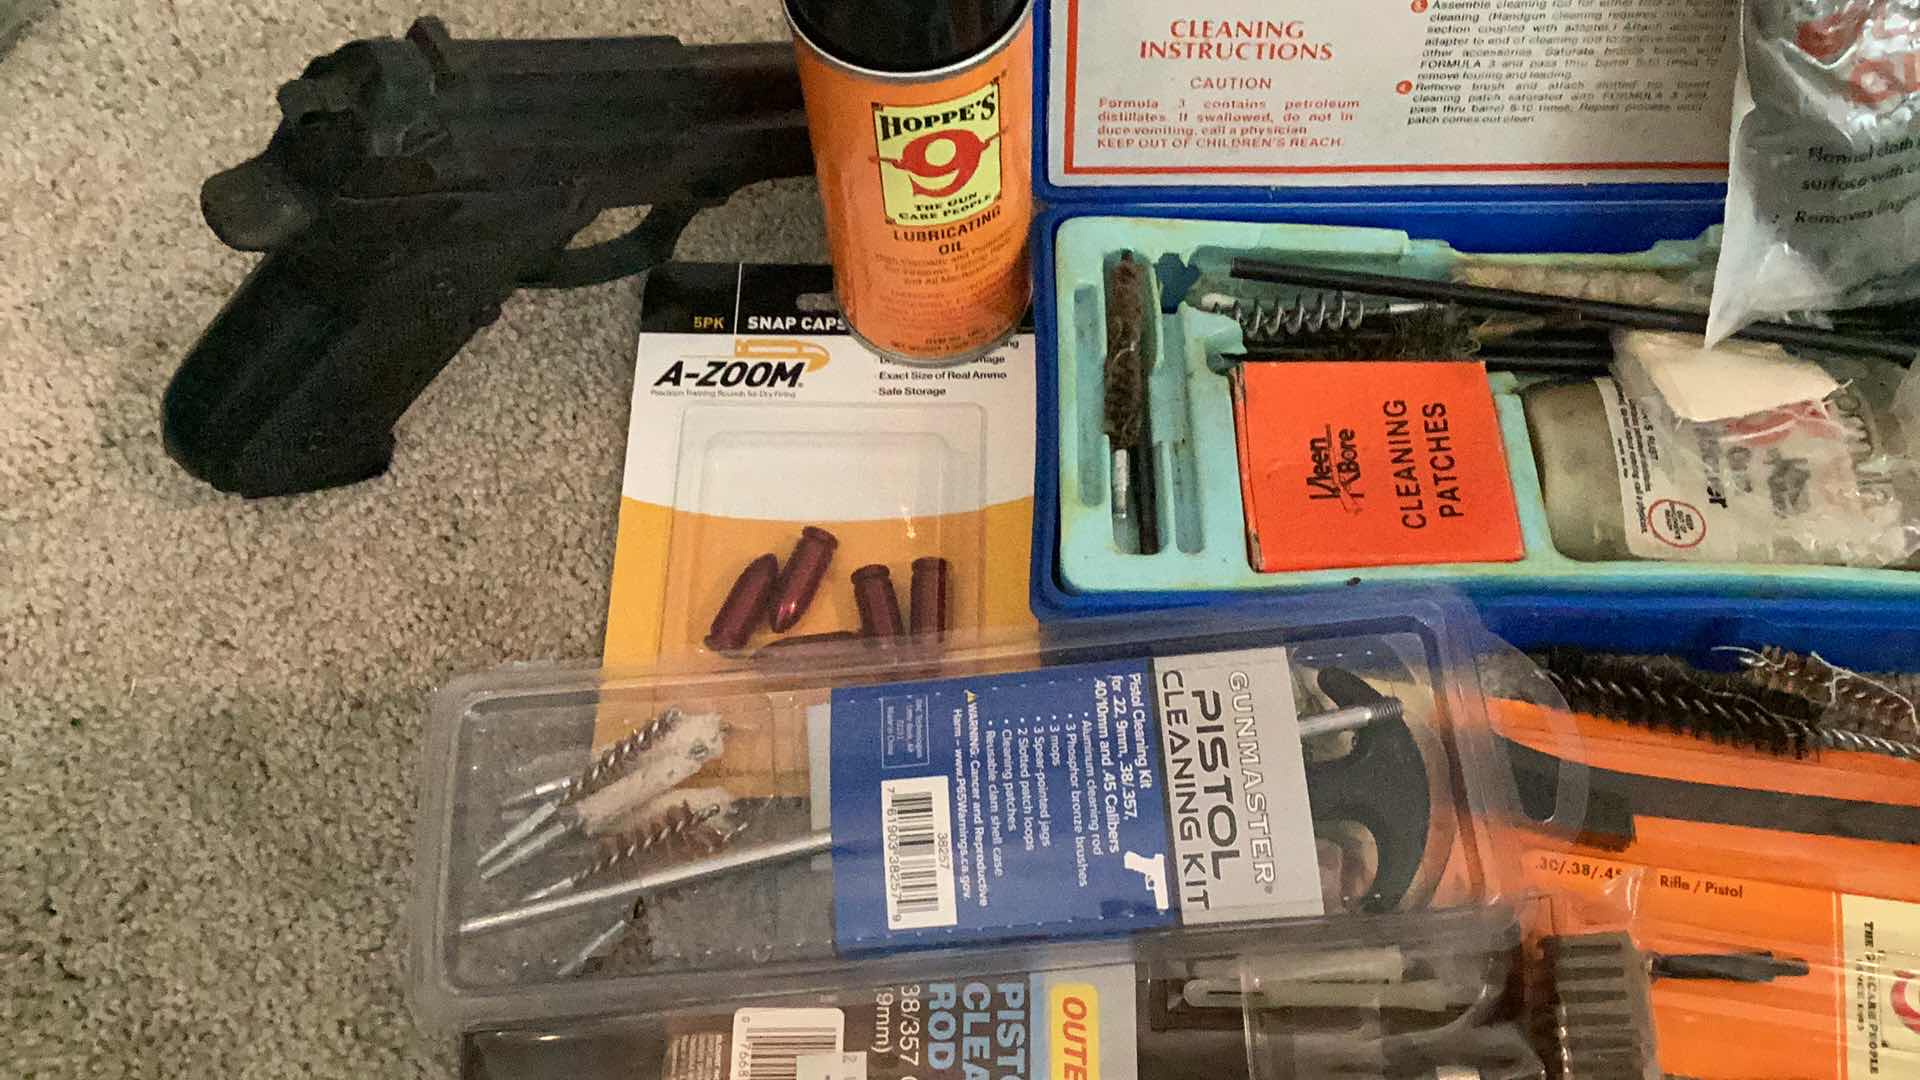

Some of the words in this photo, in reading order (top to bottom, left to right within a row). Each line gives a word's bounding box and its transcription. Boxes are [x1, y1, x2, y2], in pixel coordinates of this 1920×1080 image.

[1170, 19, 1304, 38] CLEANING
[1426, 25, 1470, 34] section
[1533, 24, 1558, 33] with
[1429, 12, 1480, 22] cleaning
[1139, 41, 1333, 60] INSTRUCTIONS
[1419, 59, 1481, 69] FORMULA
[1422, 49, 1453, 58] other
[1190, 77, 1272, 90] CAUTION
[1415, 82, 1462, 91] Remove
[1098, 97, 1159, 109] Formula
[1203, 99, 1267, 109] contains
[1284, 99, 1360, 111] petroleum
[1409, 106, 1437, 115] pass
[1442, 104, 1466, 114] thru
[1412, 94, 1461, 104] cleaning
[879, 92, 997, 141] HOPPE'S
[1097, 124, 1131, 135] duce
[1201, 124, 1228, 135] call
[1229, 126, 1237, 135] a
[1196, 111, 1274, 124] swallowed,
[1283, 111, 1300, 122] do
[1308, 112, 1332, 122] not
[1406, 116, 1440, 126] patch
[1441, 116, 1480, 125] comes
[1481, 115, 1501, 124] out
[1097, 138, 1135, 149] KEEP
[1138, 138, 1168, 148] OUT
[1171, 138, 1191, 148] OF
[1196, 137, 1286, 149] CHILDREN'S
[895, 129, 988, 197] 9
[1801, 178, 1868, 192] surface
[898, 211, 938, 221] CARE
[943, 195, 992, 217] PEOPLE
[914, 202, 943, 212] THE
[947, 192, 979, 207] GUN
[1795, 209, 1874, 224] Removes
[893, 204, 1001, 242] LUBRICATING
[938, 241, 962, 256] OIL
[693, 316, 725, 330] 5PK
[747, 316, 797, 330] SNAP
[800, 317, 847, 331] CAPS
[653, 360, 806, 388] A-ZOOM
[878, 371, 909, 381] Exact
[911, 371, 933, 380] Size
[935, 371, 946, 380] of
[947, 370, 970, 380] Real
[972, 370, 1007, 381] Ammo
[878, 387, 903, 396] Safe
[904, 387, 947, 398] Storage
[1383, 399, 1427, 529] CLEANING
[1422, 401, 1465, 518] PATCHES
[1108, 675, 1123, 692] for
[1129, 673, 1144, 707] Pistol
[953, 707, 963, 737] Harm
[967, 703, 981, 759] WARNING:
[1017, 727, 1028, 736] 2
[1034, 726, 1044, 735] 3
[1050, 724, 1060, 732] 3
[1066, 723, 1076, 731] 3
[1050, 734, 1061, 768] mops
[1082, 719, 1096, 778] Aluminum
[1133, 710, 1149, 766] Cleaning
[986, 730, 997, 782] Reusable
[1002, 728, 1013, 780] Cleaning
[1018, 736, 1031, 778] Slotted
[1066, 732, 1080, 790] Phosphor
[1099, 740, 1115, 767] and
[1162, 669, 1203, 841] CLEANING
[887, 786, 895, 794] 7
[970, 759, 981, 800] Cancer
[1034, 735, 1050, 817] Spear-pointed
[1139, 769, 1153, 789] Kit
[1191, 690, 1240, 881] PISTOL
[1228, 671, 1276, 886] GUNMASTER
[988, 784, 1000, 813] clam
[1003, 782, 1017, 832] patches
[1019, 780, 1033, 815] patch
[1071, 790, 1083, 833] bronze
[1086, 779, 1102, 832] cleaning
[972, 801, 985, 825] and
[1104, 794, 1121, 854] Calibers
[887, 808, 899, 849] 61903
[990, 814, 1002, 845] shell
[1023, 816, 1035, 851] loops
[1038, 819, 1051, 848] jags
[937, 832, 951, 869] 38257
[1092, 834, 1104, 856] rod
[973, 826, 988, 907] Reproductive
[992, 847, 1003, 878] case
[1075, 836, 1089, 888] brushes
[888, 856, 902, 899] 38257
[1182, 853, 1211, 912] KIT
[1659, 874, 1691, 891] Rifle
[1704, 881, 1744, 899] Pistol
[892, 913, 902, 922] 9
[1864, 920, 1874, 948] THE
[927, 983, 957, 1070] ROD
[996, 982, 1026, 1080] PIST
[1868, 1023, 1879, 1074] PEOPLE
